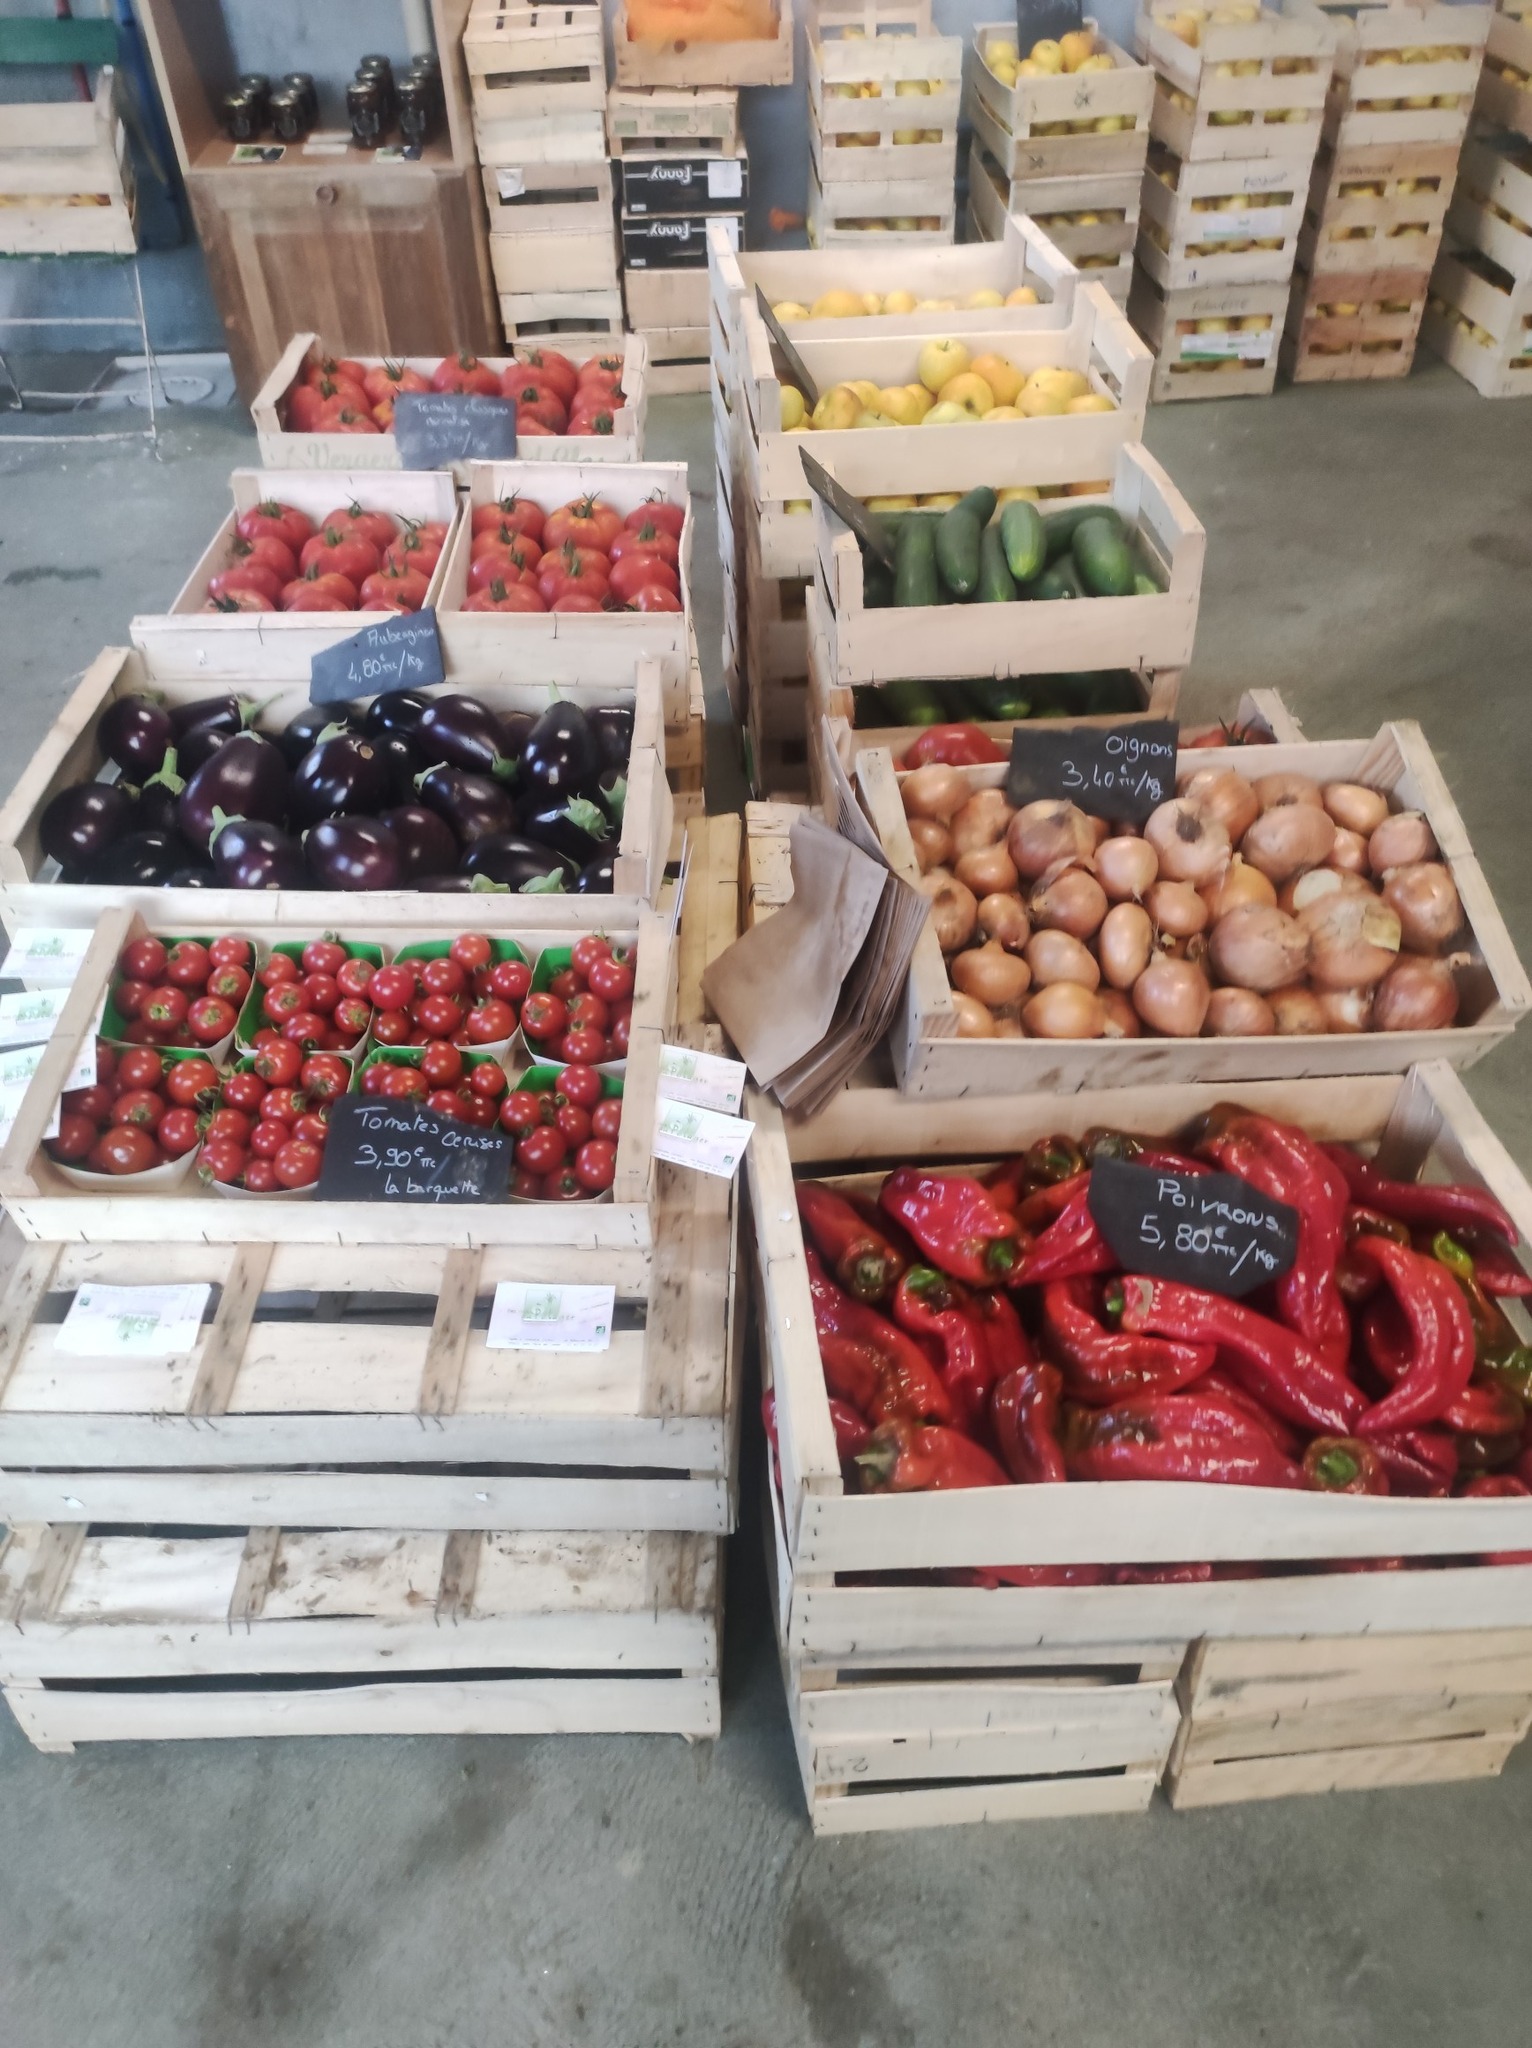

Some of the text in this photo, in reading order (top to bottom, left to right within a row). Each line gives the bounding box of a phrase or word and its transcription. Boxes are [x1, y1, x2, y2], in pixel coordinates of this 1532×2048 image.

[1105, 735, 1173, 764] Oignons
[353, 1105, 503, 1151] Tomates Cerises
[385, 1173, 481, 1202] la barquette
